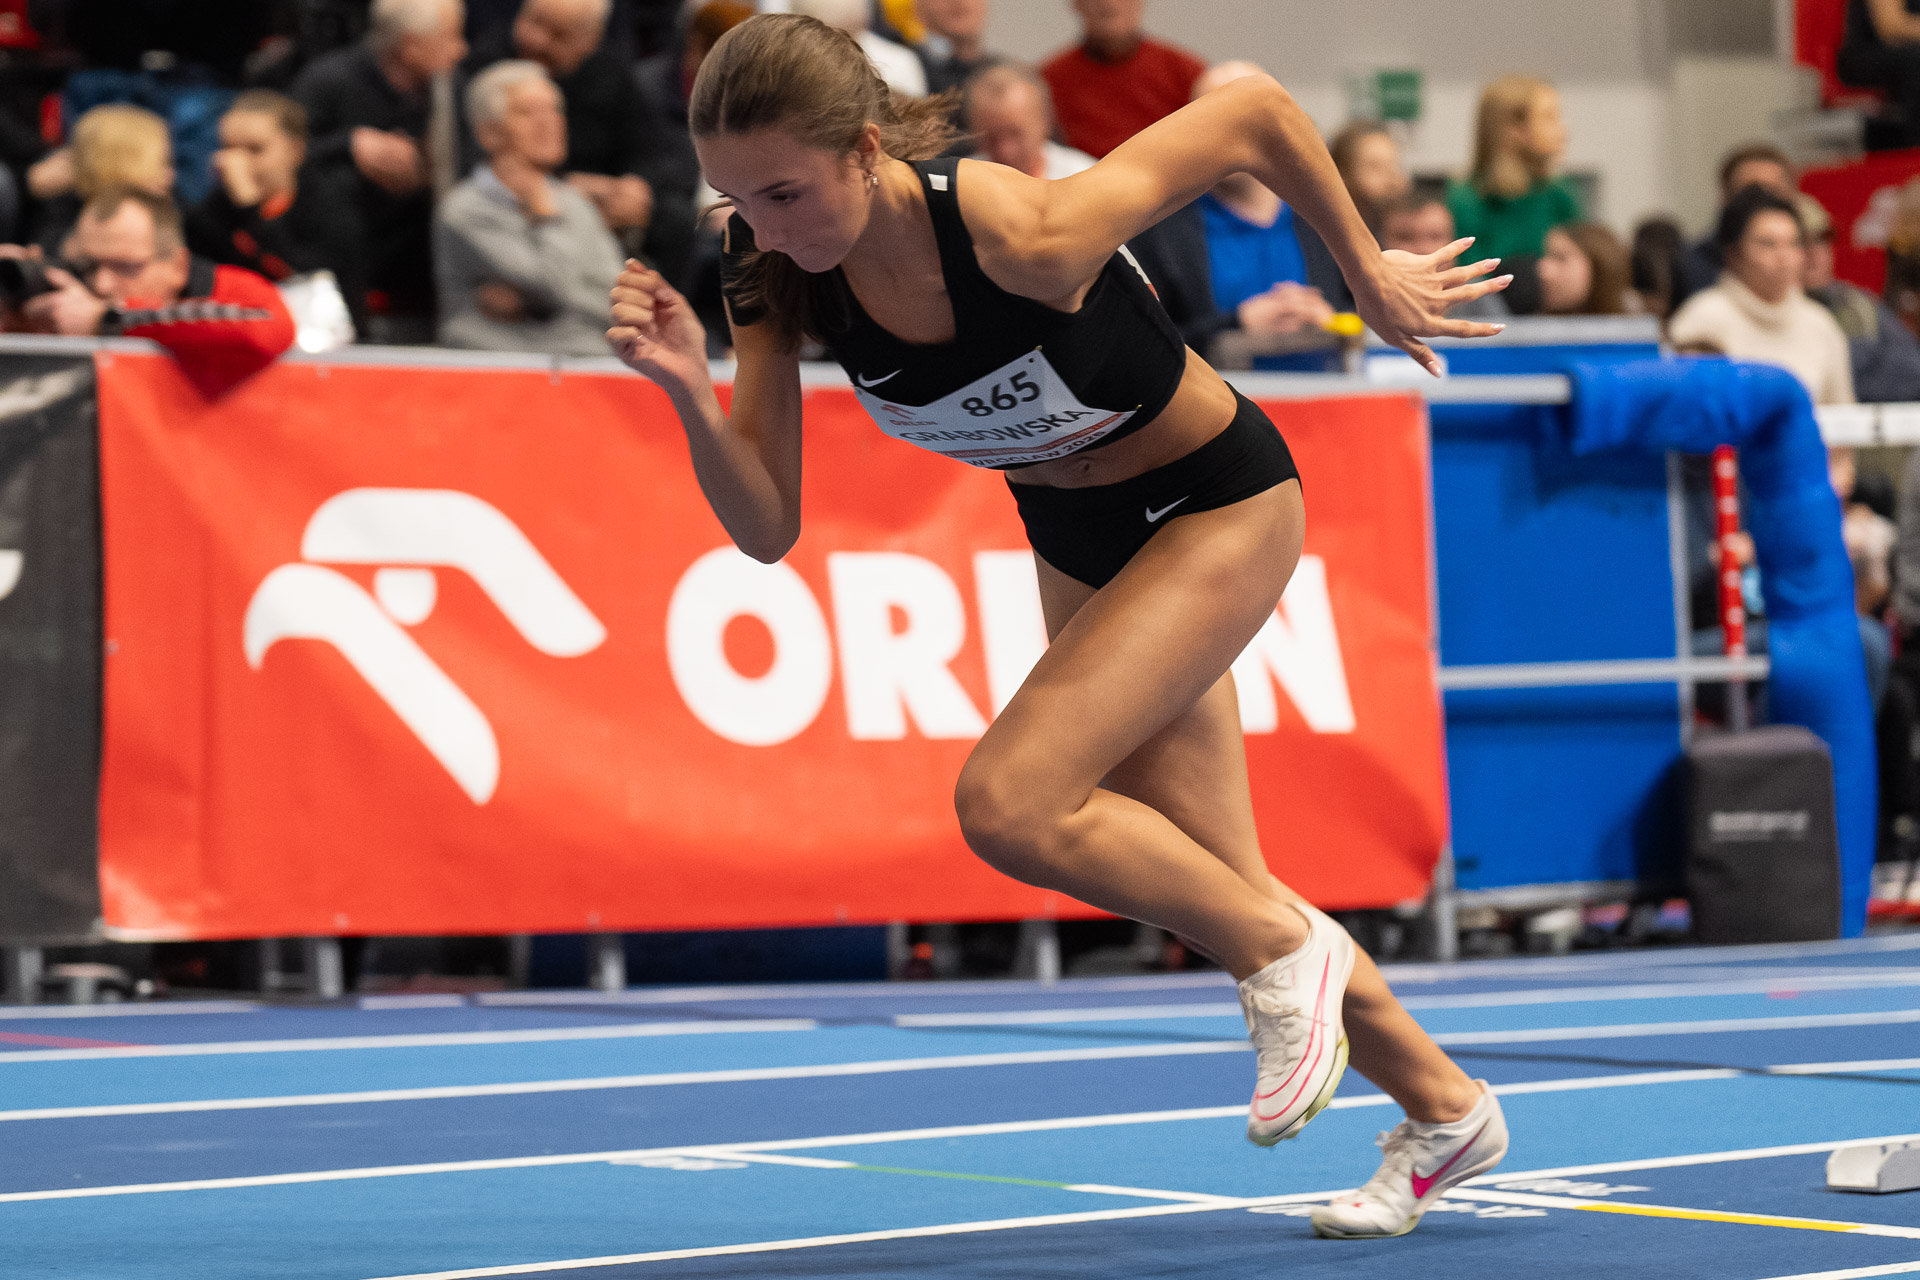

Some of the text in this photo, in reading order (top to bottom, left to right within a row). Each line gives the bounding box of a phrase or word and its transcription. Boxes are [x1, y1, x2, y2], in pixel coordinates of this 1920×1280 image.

[961, 370, 1041, 417] 865
[899, 409, 1095, 443] GRABOWSKA
[666, 544, 1357, 747] ORLN
